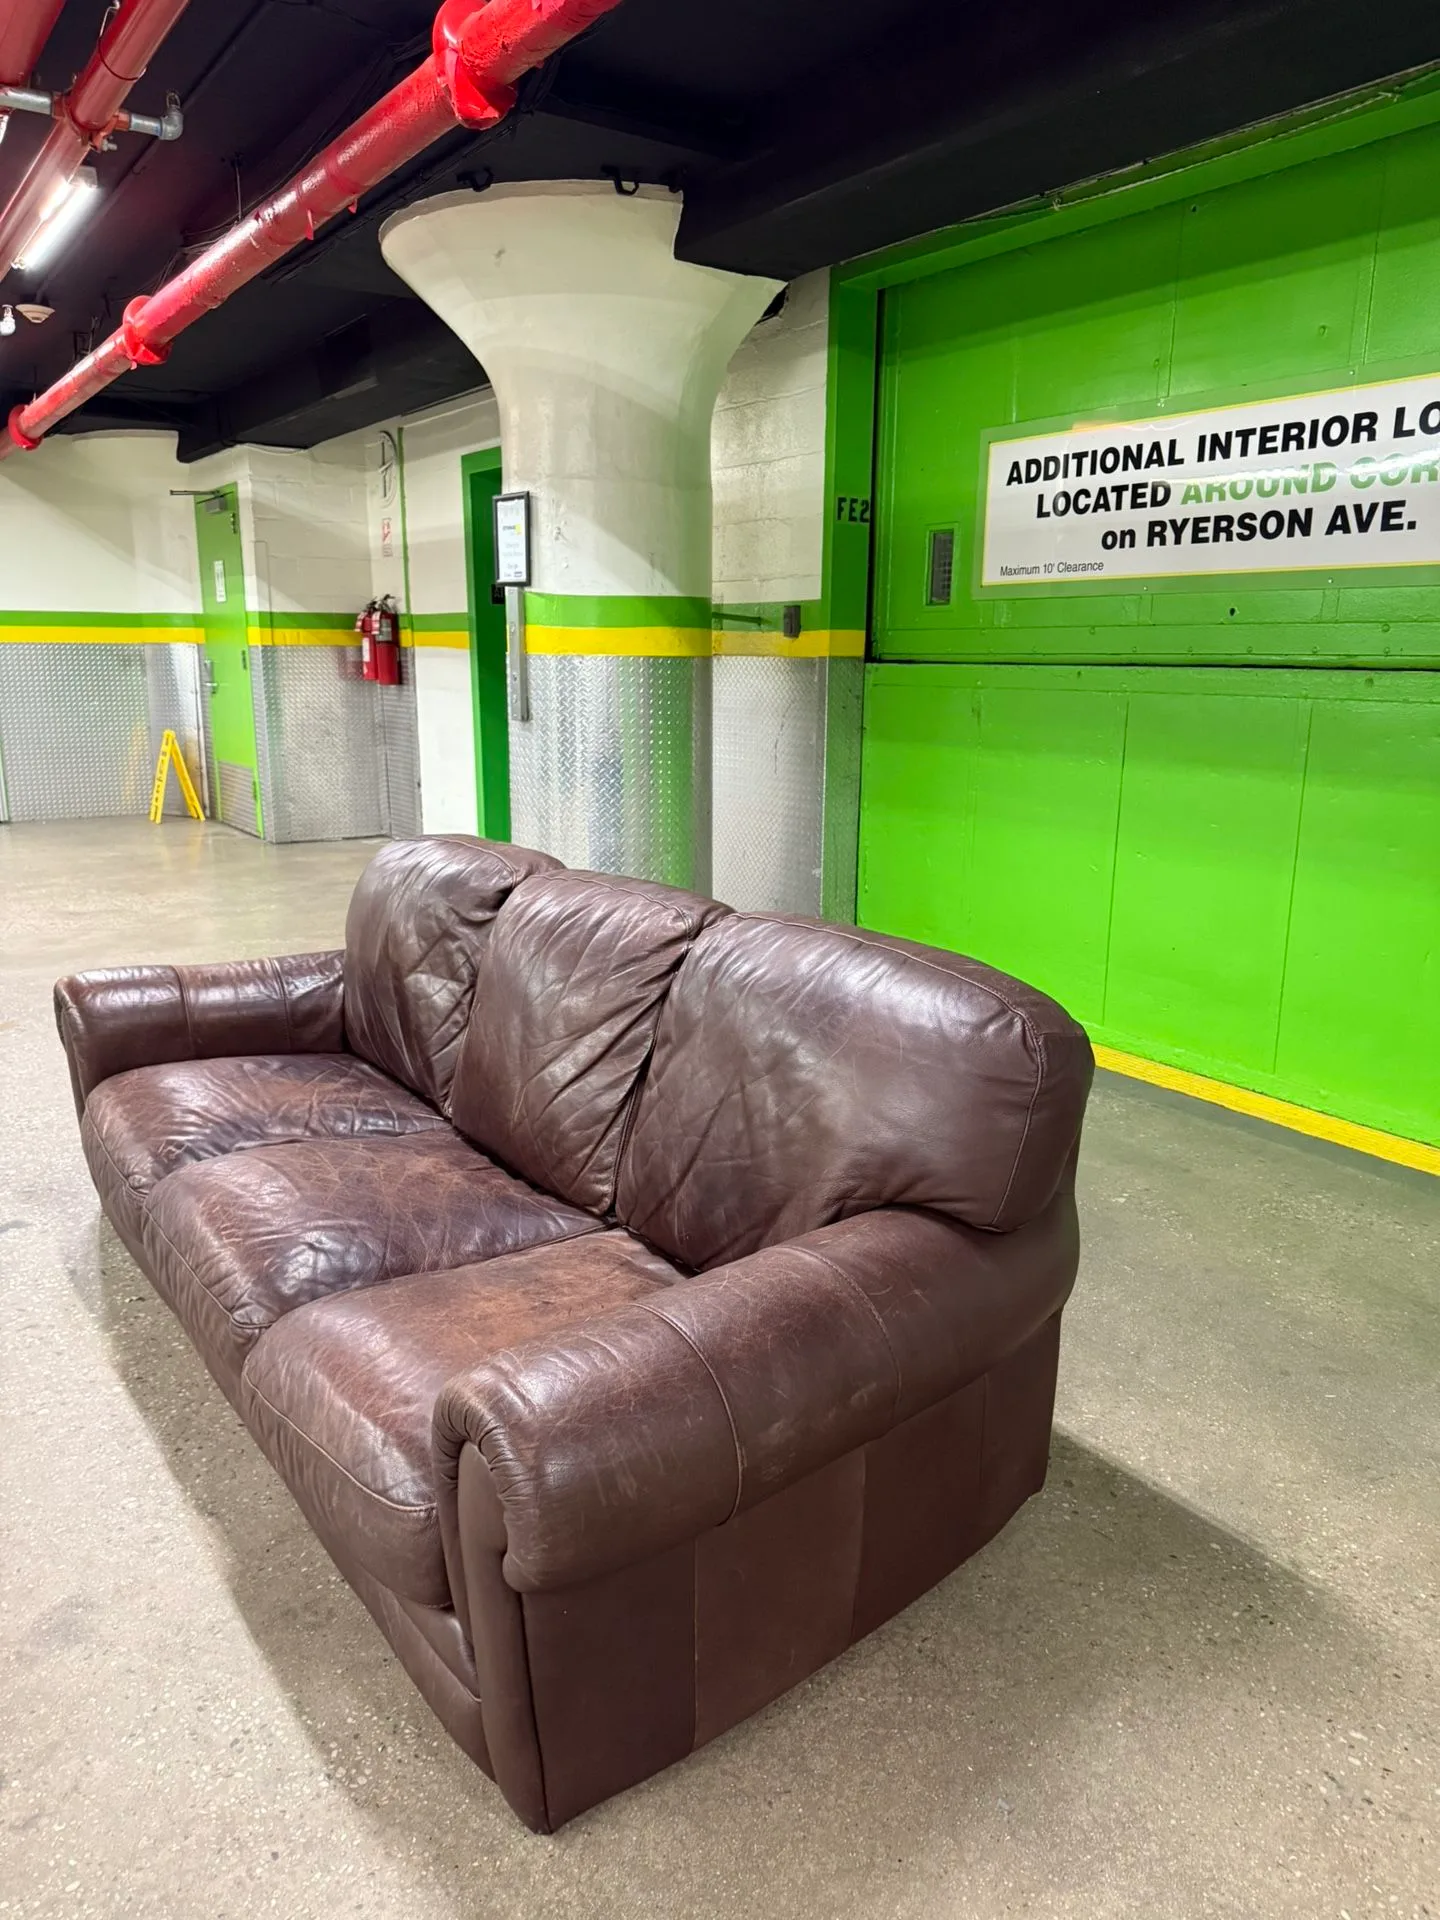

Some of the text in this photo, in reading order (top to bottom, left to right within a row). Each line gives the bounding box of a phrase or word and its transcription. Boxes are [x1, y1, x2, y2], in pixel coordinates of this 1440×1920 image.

[1006, 400, 1440, 486] ADDITIONAL INTERIOR LO
[837, 496, 870, 523] FE2
[1036, 452, 1440, 519] LOCATED AROUND COR
[1101, 499, 1417, 550] on RYERSON AVE.
[1000, 565, 1040, 576] Maximum
[1057, 561, 1104, 573] Clearance
